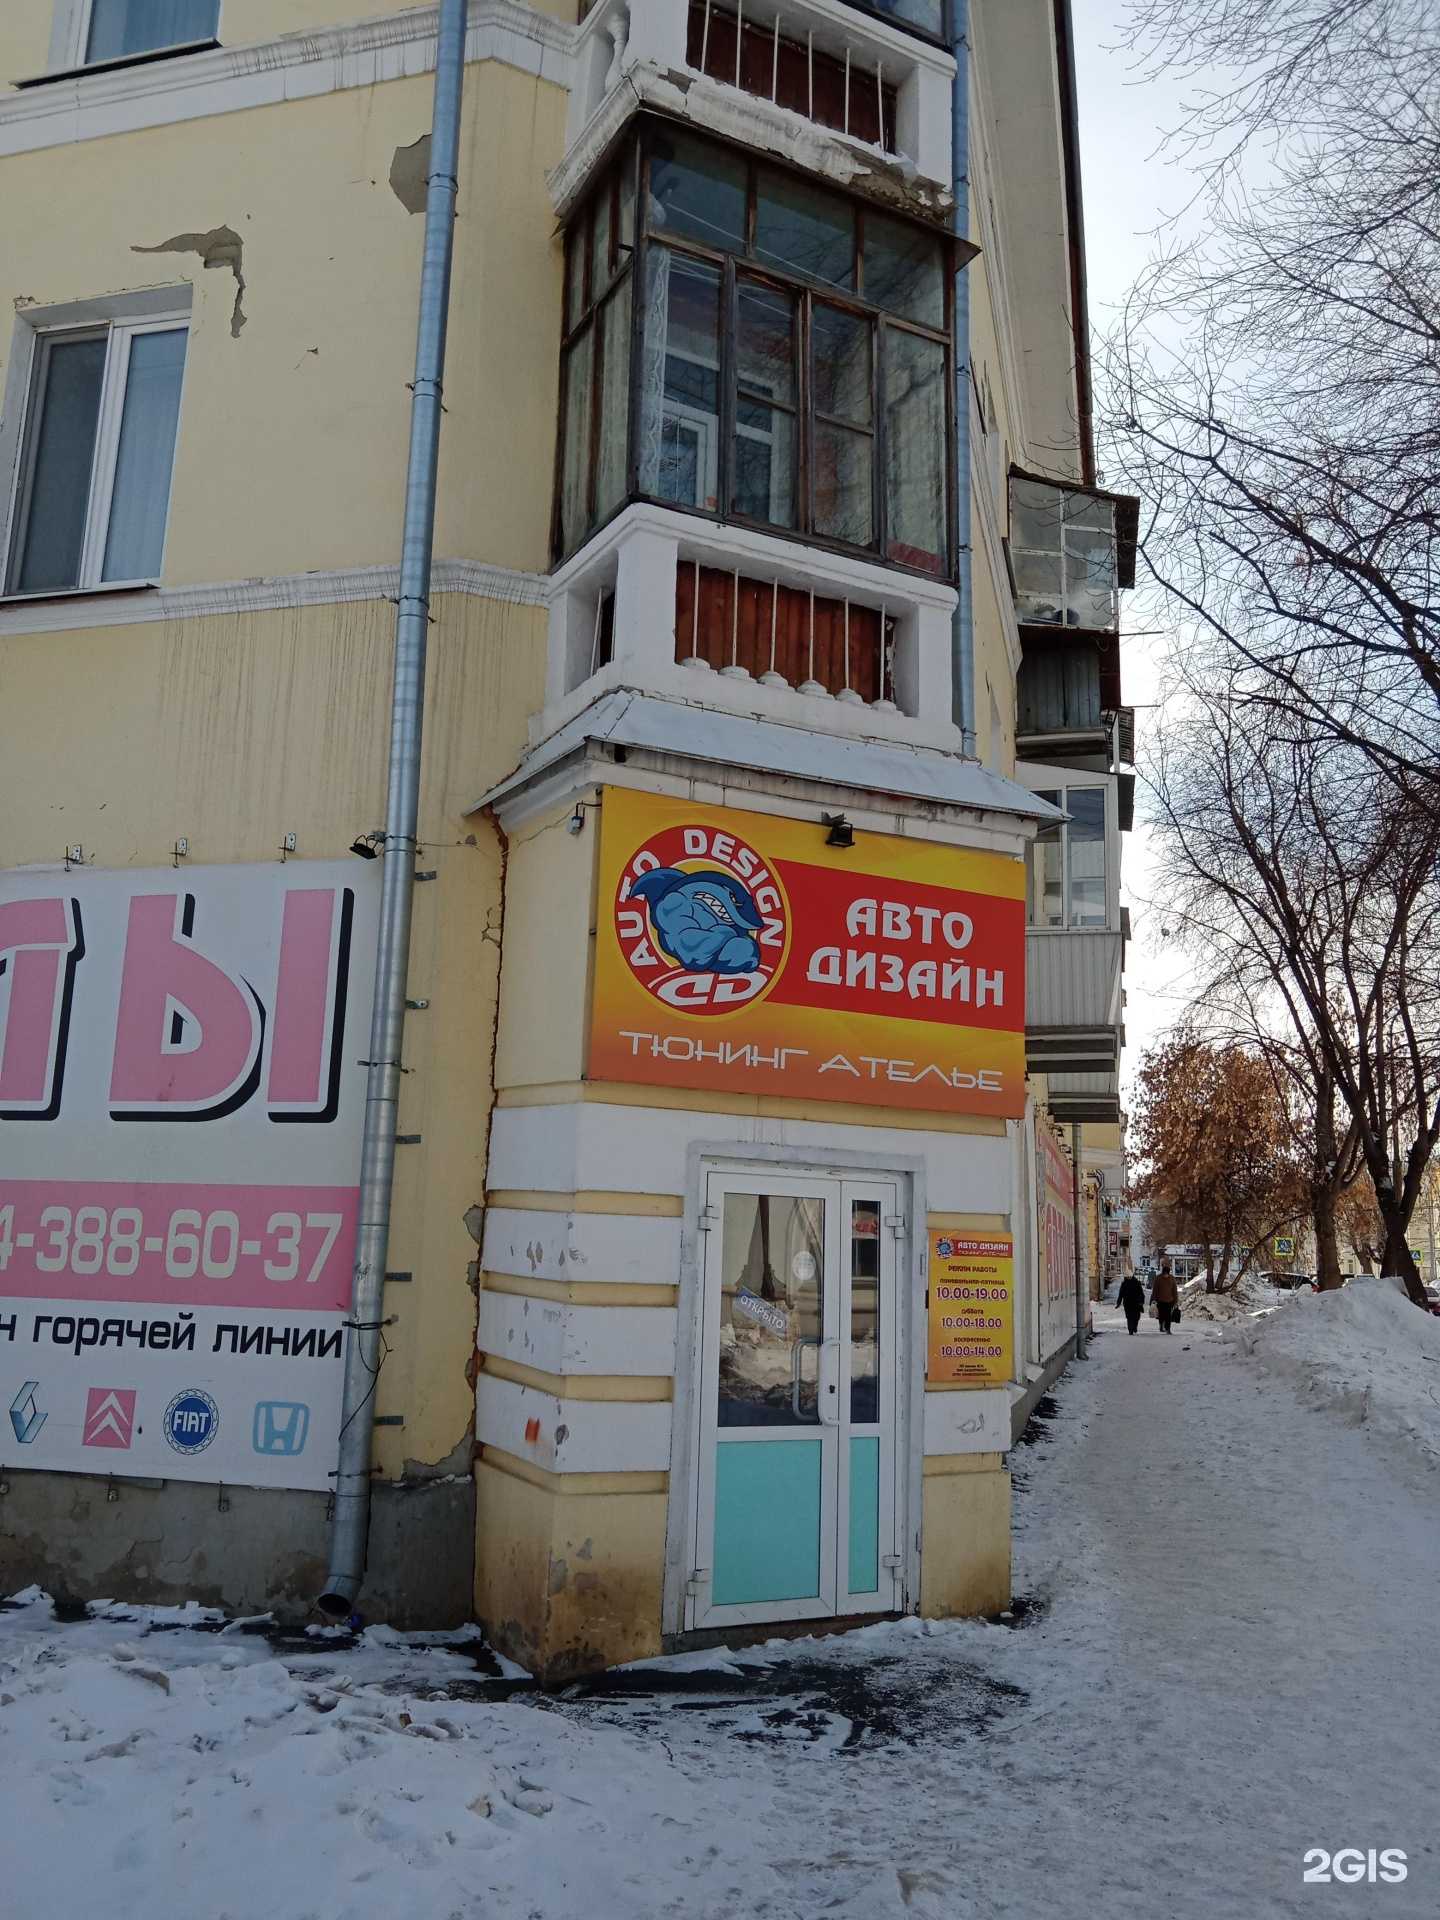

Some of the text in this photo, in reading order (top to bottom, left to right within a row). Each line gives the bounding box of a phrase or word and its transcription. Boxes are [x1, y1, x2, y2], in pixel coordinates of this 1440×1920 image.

[618, 829, 785, 967] AUTO DESIGN
[846, 898, 974, 949] АВТО
[806, 947, 1004, 1008] ДИЗАЙН
[618, 1031, 1004, 1092] ТЮНИНГ АТЕЛЬЕ
[958, 1241, 1009, 1251] АВТО ДИЗАЙН
[936, 1287, 1008, 1300] 10.00-19.00
[740, 1295, 785, 1329] ОТКРЫТО
[942, 1317, 1002, 1328] 10.00-18.00
[32, 1312, 198, 1356] горячей
[211, 1324, 344, 1359] линии
[942, 1345, 1002, 1356] 10.00-14.00
[172, 1410, 209, 1433] FIAT
